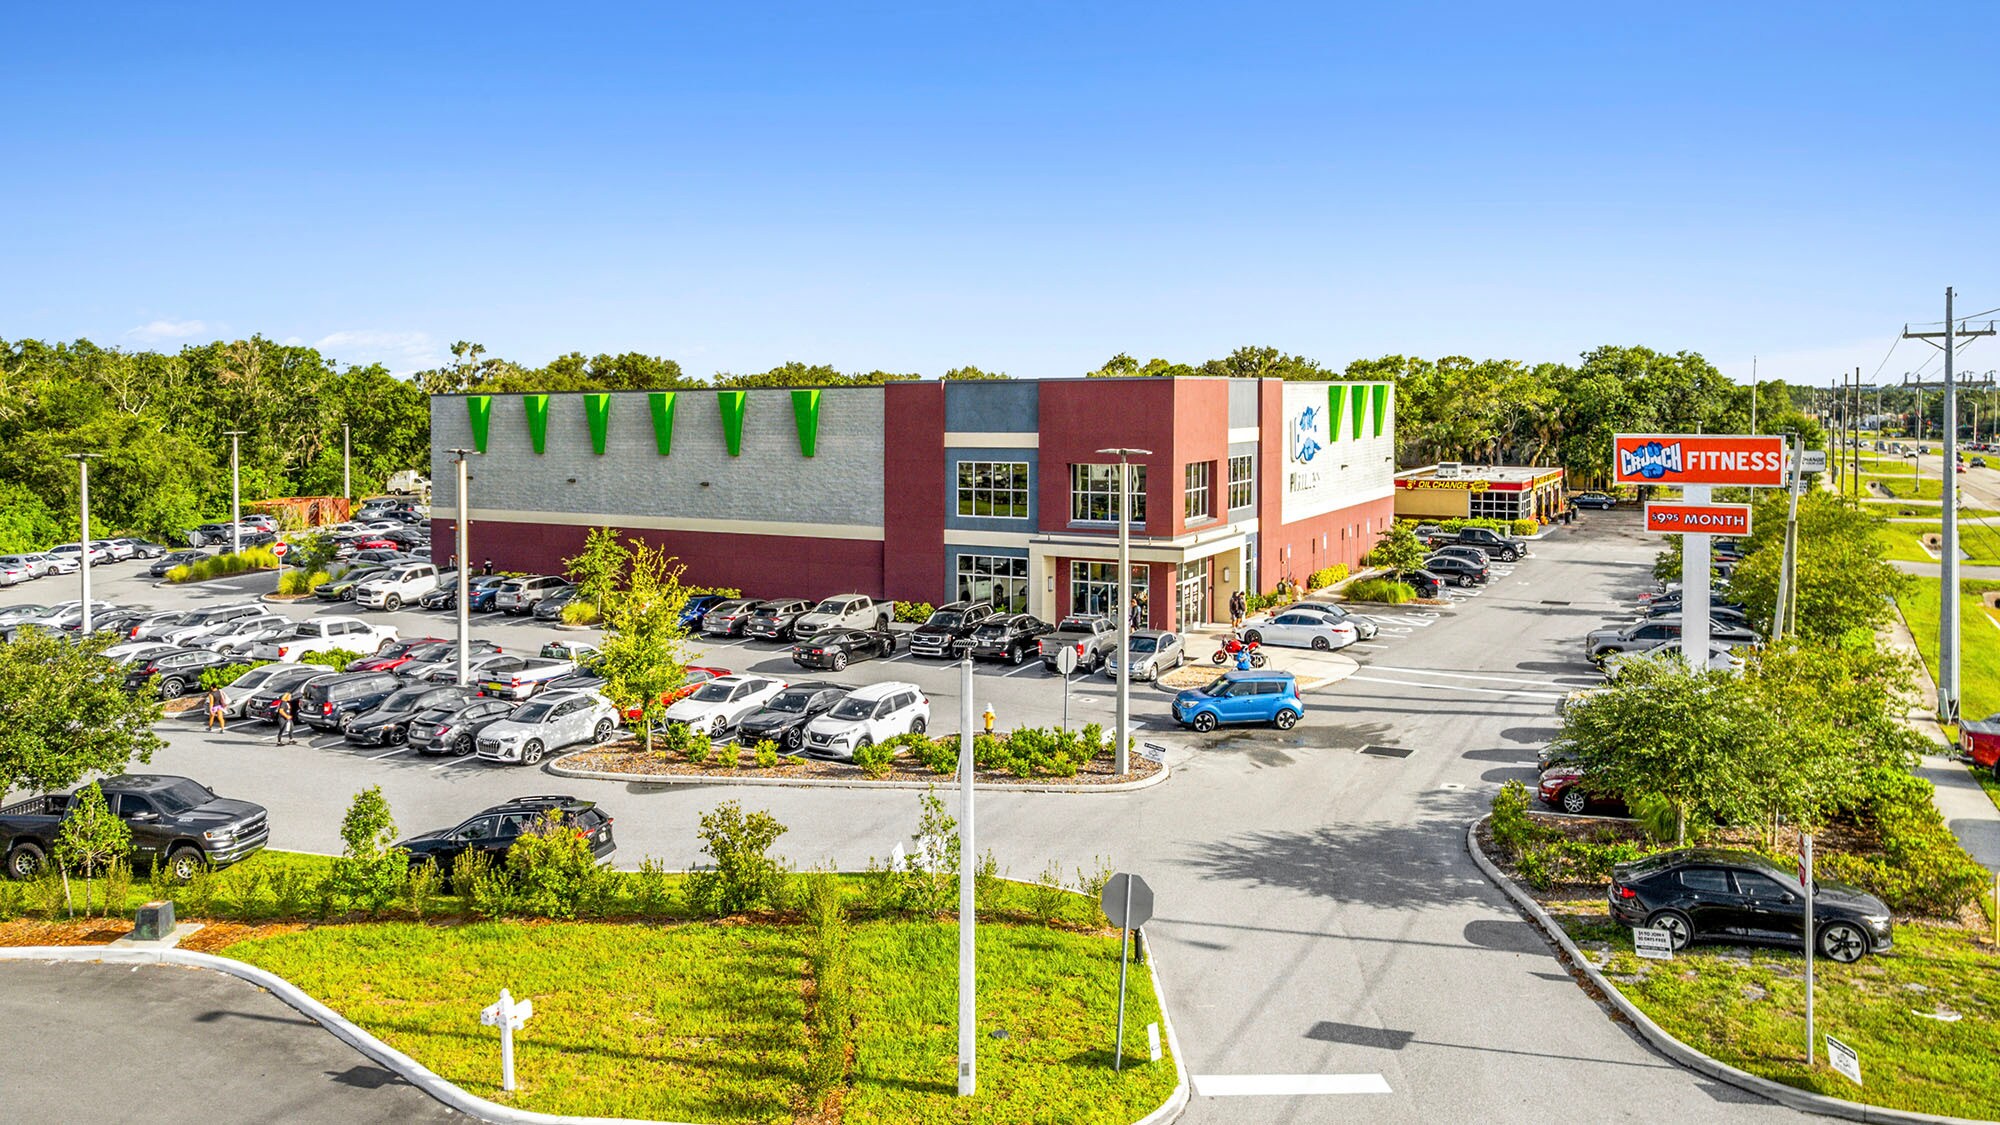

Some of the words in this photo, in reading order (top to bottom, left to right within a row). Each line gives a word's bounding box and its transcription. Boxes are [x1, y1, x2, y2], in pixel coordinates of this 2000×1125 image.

[1620, 442, 1683, 476] CRUNCH
[1687, 451, 1780, 471] FITNESS
[1432, 481, 1469, 490] CHANGE
[1684, 514, 1745, 526] MONTH
